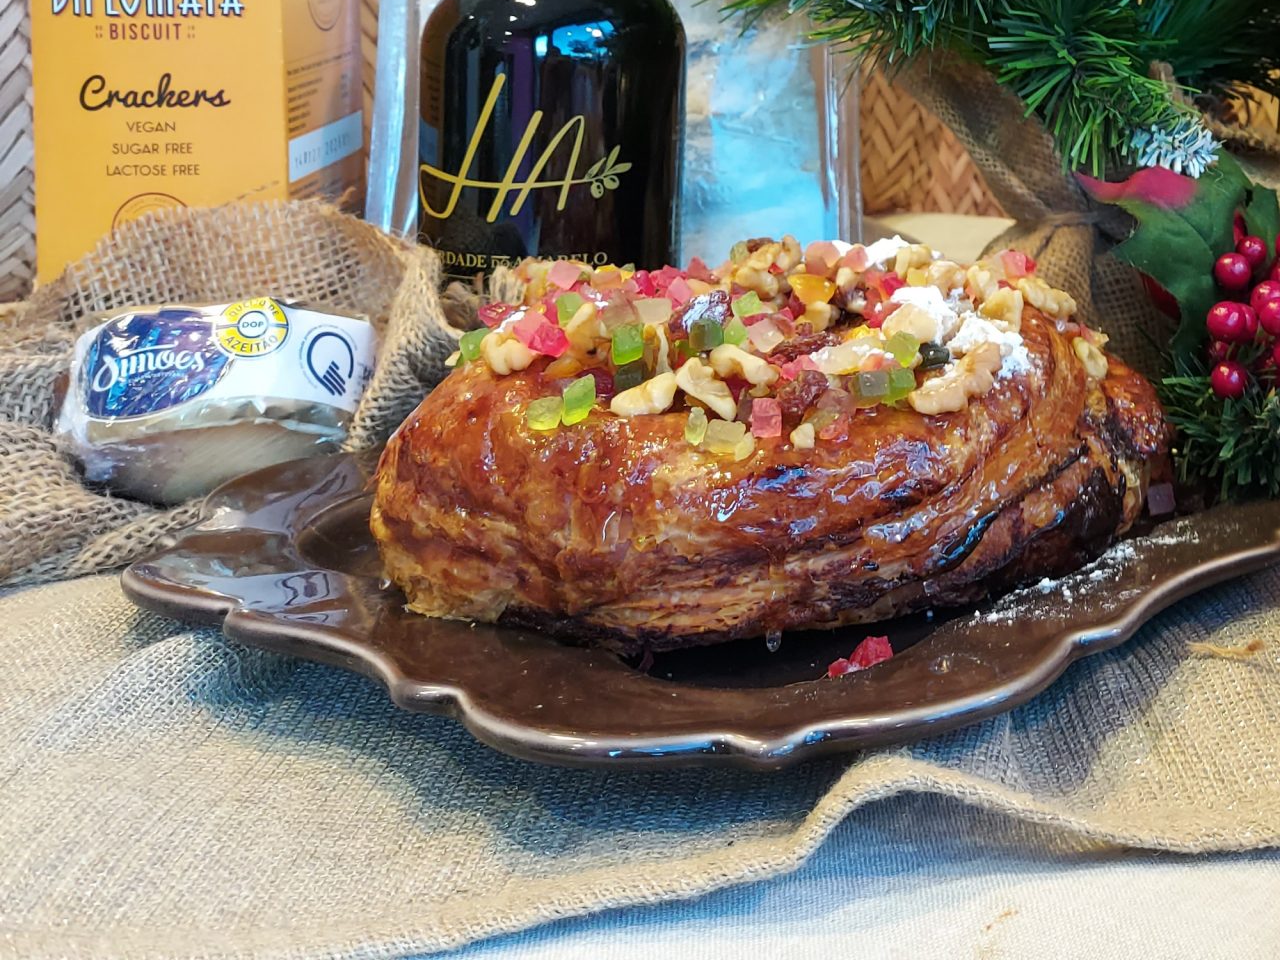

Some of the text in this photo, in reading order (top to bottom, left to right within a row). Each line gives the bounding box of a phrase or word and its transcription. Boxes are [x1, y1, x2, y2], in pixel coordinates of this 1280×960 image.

[109, 23, 182, 40] BISCUIT
[80, 73, 231, 111] Crackers
[126, 121, 176, 132] VEGAN
[112, 143, 193, 154] SUGAR FREE
[106, 164, 200, 176] LACTOSE FREE
